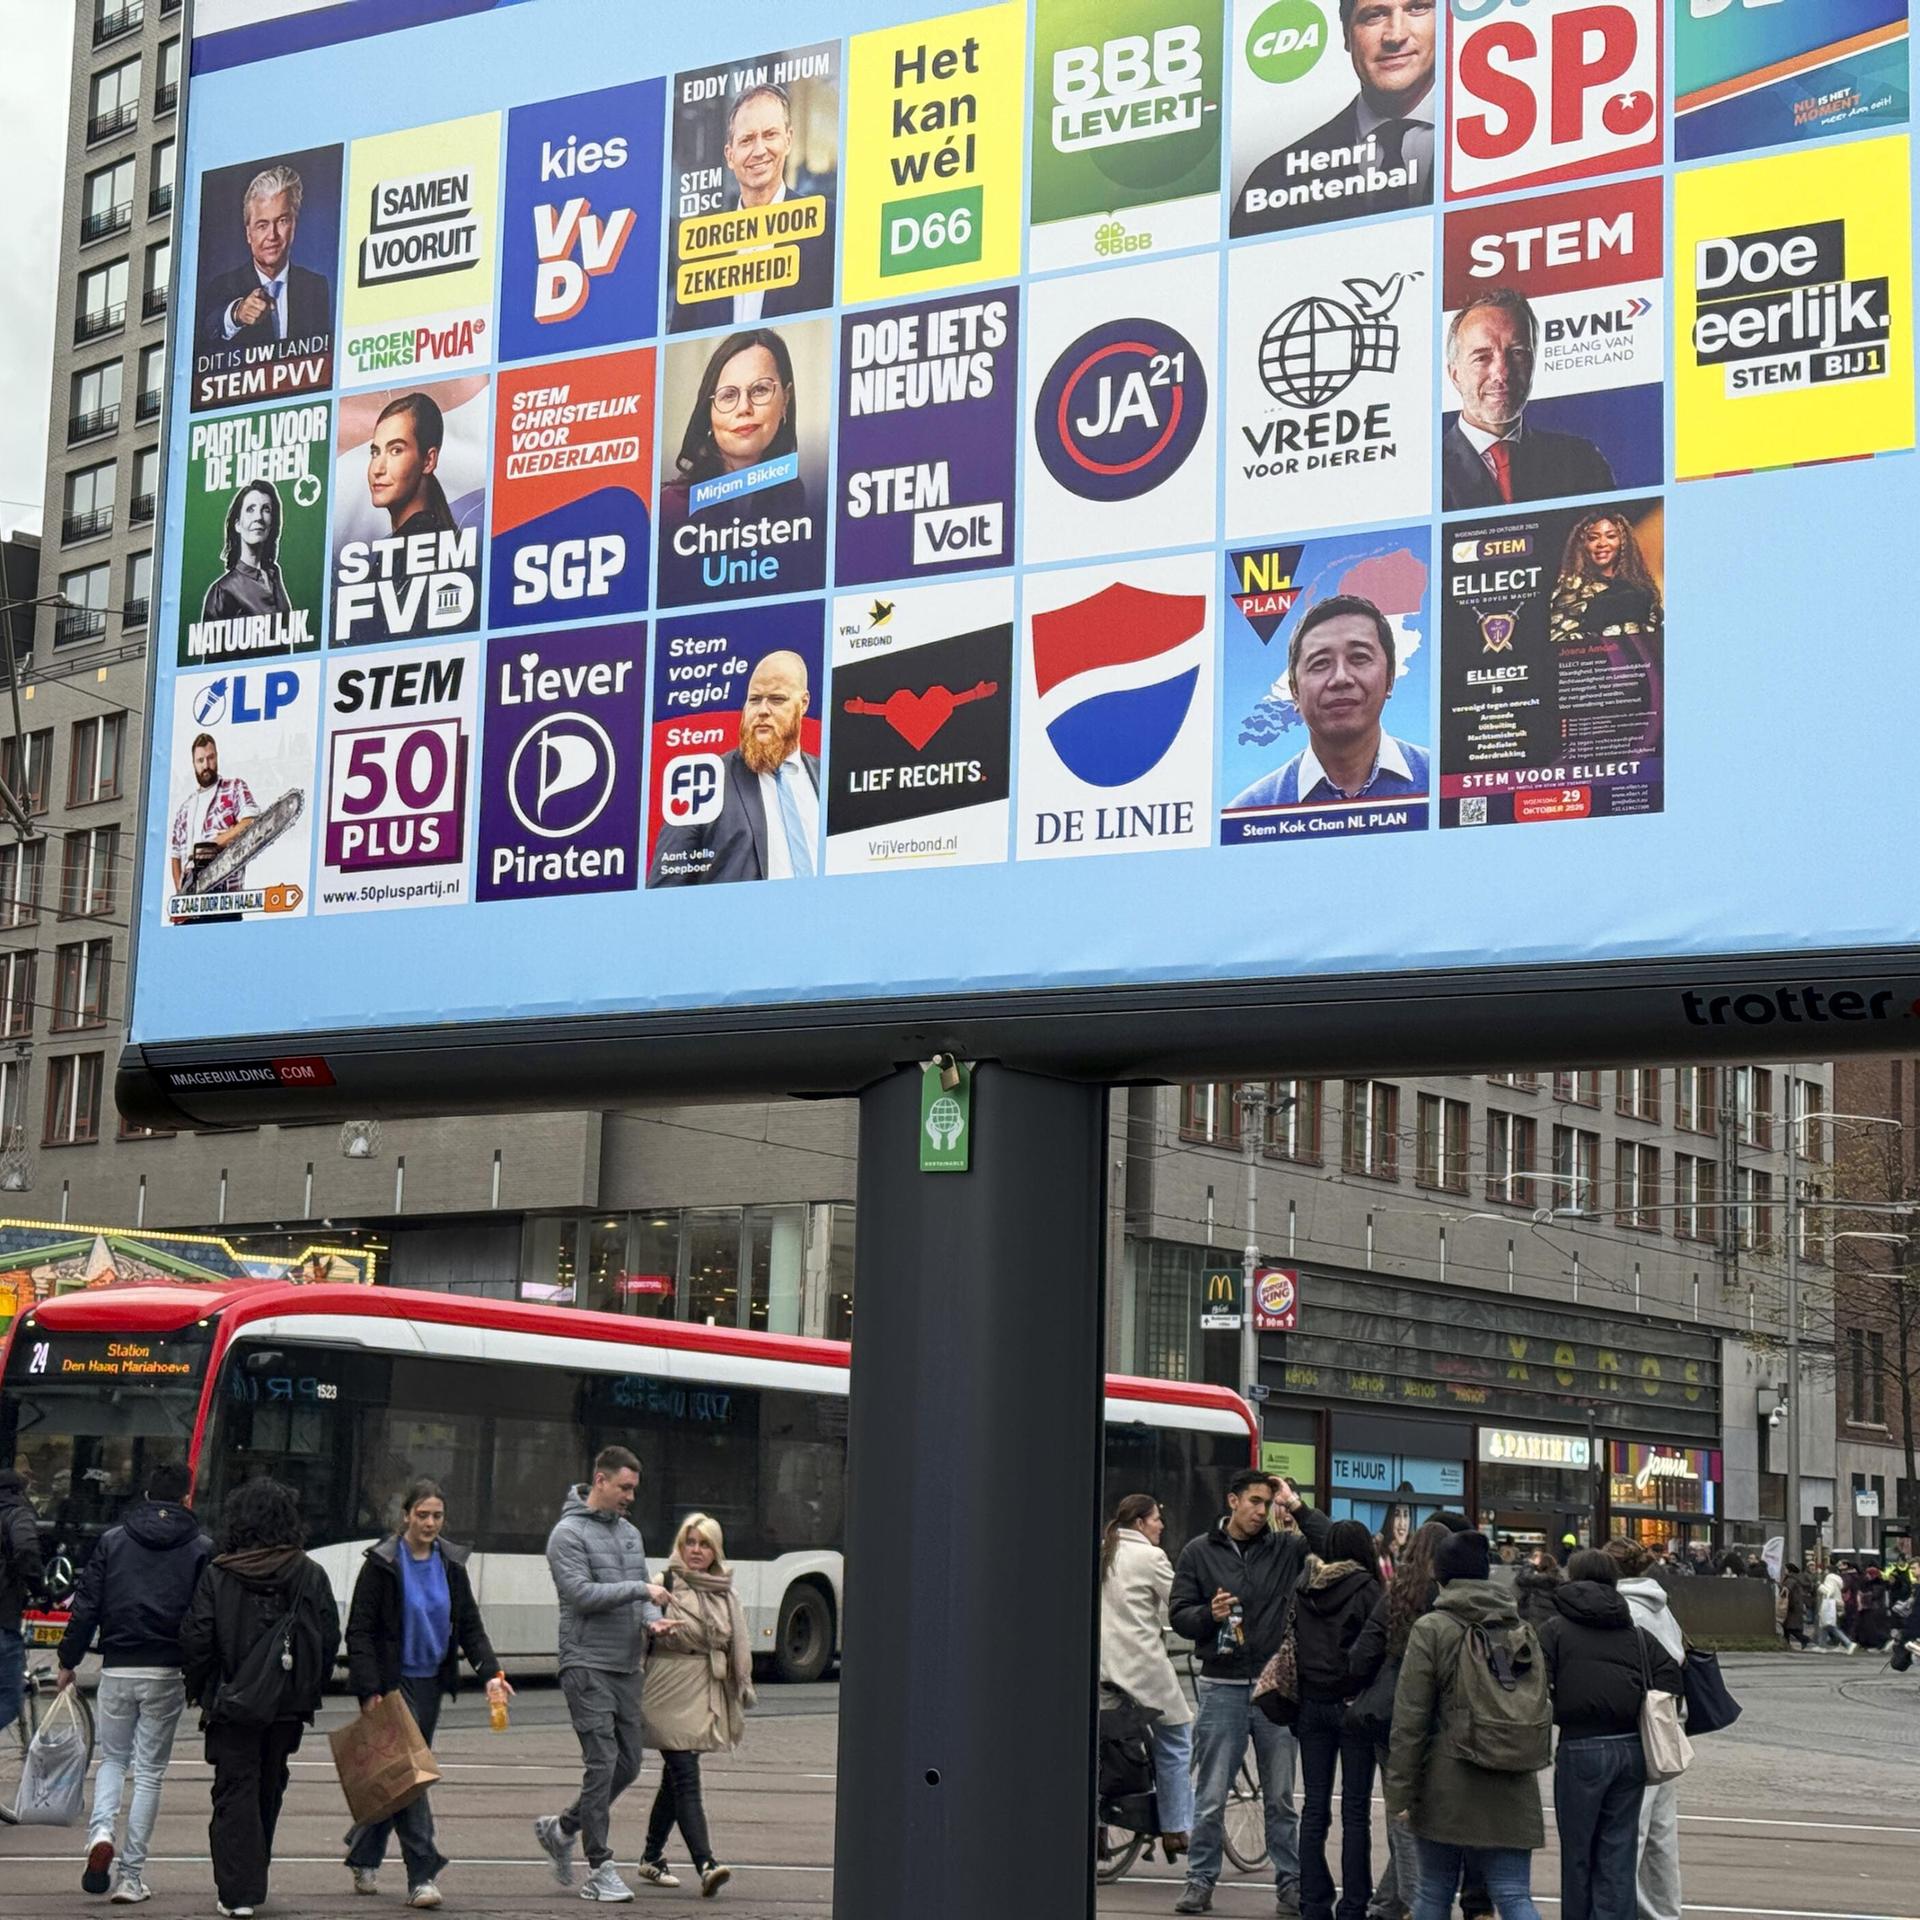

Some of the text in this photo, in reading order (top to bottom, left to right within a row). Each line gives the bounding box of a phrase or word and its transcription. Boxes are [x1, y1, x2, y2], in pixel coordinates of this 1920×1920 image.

[1253, 23, 1318, 58] CDA
[683, 53, 829, 103] EDDY VAN HIJUM
[894, 38, 979, 88] Het
[1053, 24, 1203, 105] BBB
[893, 93, 976, 138] kan
[1794, 87, 1851, 114] NU IS HET
[1794, 95, 1860, 126] MOMENT
[541, 135, 628, 182] kies
[890, 133, 976, 186] wél
[1286, 134, 1376, 177] Henri
[383, 174, 469, 216] SAMEN
[680, 167, 722, 193] STEM
[1245, 160, 1417, 213] Bontenbal
[371, 224, 477, 269] VOORUIT
[685, 207, 818, 250] ZORGEN VOOR
[890, 208, 972, 256] D66
[1110, 233, 1152, 254] BBB
[1469, 211, 1634, 278] STEM
[683, 256, 792, 295] ZEKERHEID!
[1697, 235, 1817, 290] Doe
[851, 301, 1008, 369] DOE IETS
[1544, 309, 1633, 343] BVNL
[1692, 284, 1889, 354] eerlijk.
[198, 337, 329, 373] DIT IS UW LAND!
[348, 320, 474, 363] GROEN PvdA
[1544, 335, 1633, 358] BELANG VAN
[358, 349, 414, 372] LINKS
[1544, 349, 1634, 373] NEDERLAND
[1732, 347, 1880, 389] STEM BIJ1
[201, 359, 324, 400] STEM PVV
[512, 384, 570, 411] STEM
[850, 352, 993, 416] NIEUWS
[511, 394, 641, 431] CHRISTELIJK
[1242, 403, 1392, 458] VREDE
[191, 405, 328, 460] PARTIJ VOOR
[512, 427, 569, 452] VOOR
[205, 443, 311, 492] DE DIEREN
[510, 440, 636, 476] NEDERLAND
[1243, 442, 1397, 479] VOOR DIEREN
[696, 462, 790, 502] Mirjam Bikker
[848, 461, 949, 519] STEM
[673, 517, 813, 556] Christen
[924, 515, 992, 552] Volt
[1483, 538, 1526, 556] STEM
[338, 526, 477, 584] STEM
[513, 534, 626, 605] SGP
[702, 550, 779, 587] Unie
[1243, 552, 1291, 594] NL
[1452, 566, 1542, 597] ELLECT
[335, 572, 475, 640] FVD
[1243, 594, 1291, 614] PLAN
[188, 609, 314, 656] NATUURLIJK.
[669, 636, 727, 657] Stem
[839, 624, 861, 637] VRIJ
[849, 634, 893, 649] VERBOND
[334, 656, 465, 713] STEM
[501, 653, 633, 705] Liever
[669, 656, 748, 681] voor de
[1467, 665, 1528, 682] ELLECT
[231, 670, 299, 724] LP
[667, 683, 730, 708] regio!
[1492, 684, 1503, 694] is
[666, 726, 724, 747] Stem
[342, 729, 448, 815] 50
[849, 761, 988, 793] LIEF RECHTS.
[1462, 774, 1509, 788] STEM
[1515, 768, 1565, 784] VOOR
[1573, 761, 1640, 779] ELLECT
[1523, 806, 1563, 815] OKTOBER
[1562, 790, 1580, 803] 29
[342, 817, 440, 859] PLUS
[1035, 801, 1194, 845] DE LINIE
[1243, 812, 1408, 837] Stem Kok Chan NL PLAN
[662, 851, 688, 863] Aant
[868, 835, 958, 857] VrijVerbond.nl
[492, 845, 625, 885] Piraten
[661, 861, 711, 875] Soepboer
[171, 899, 180, 914] DE
[181, 897, 199, 914] ZAAG
[200, 896, 219, 912] DOOR
[220, 895, 233, 910] DEN
[323, 879, 460, 905] www.50pluspartij.nl
[1263, 1288, 1291, 1303] KING
[30, 1342, 49, 1374] 24
[63, 1359, 190, 1374] Den Haag Mariahoeve
[107, 1343, 149, 1358] Station
[316, 1384, 337, 1399] 1523
[1404, 1382, 1437, 1399] xenos
[1334, 1460, 1386, 1480] TE HUUR
[1636, 1446, 1699, 1490] jamin
